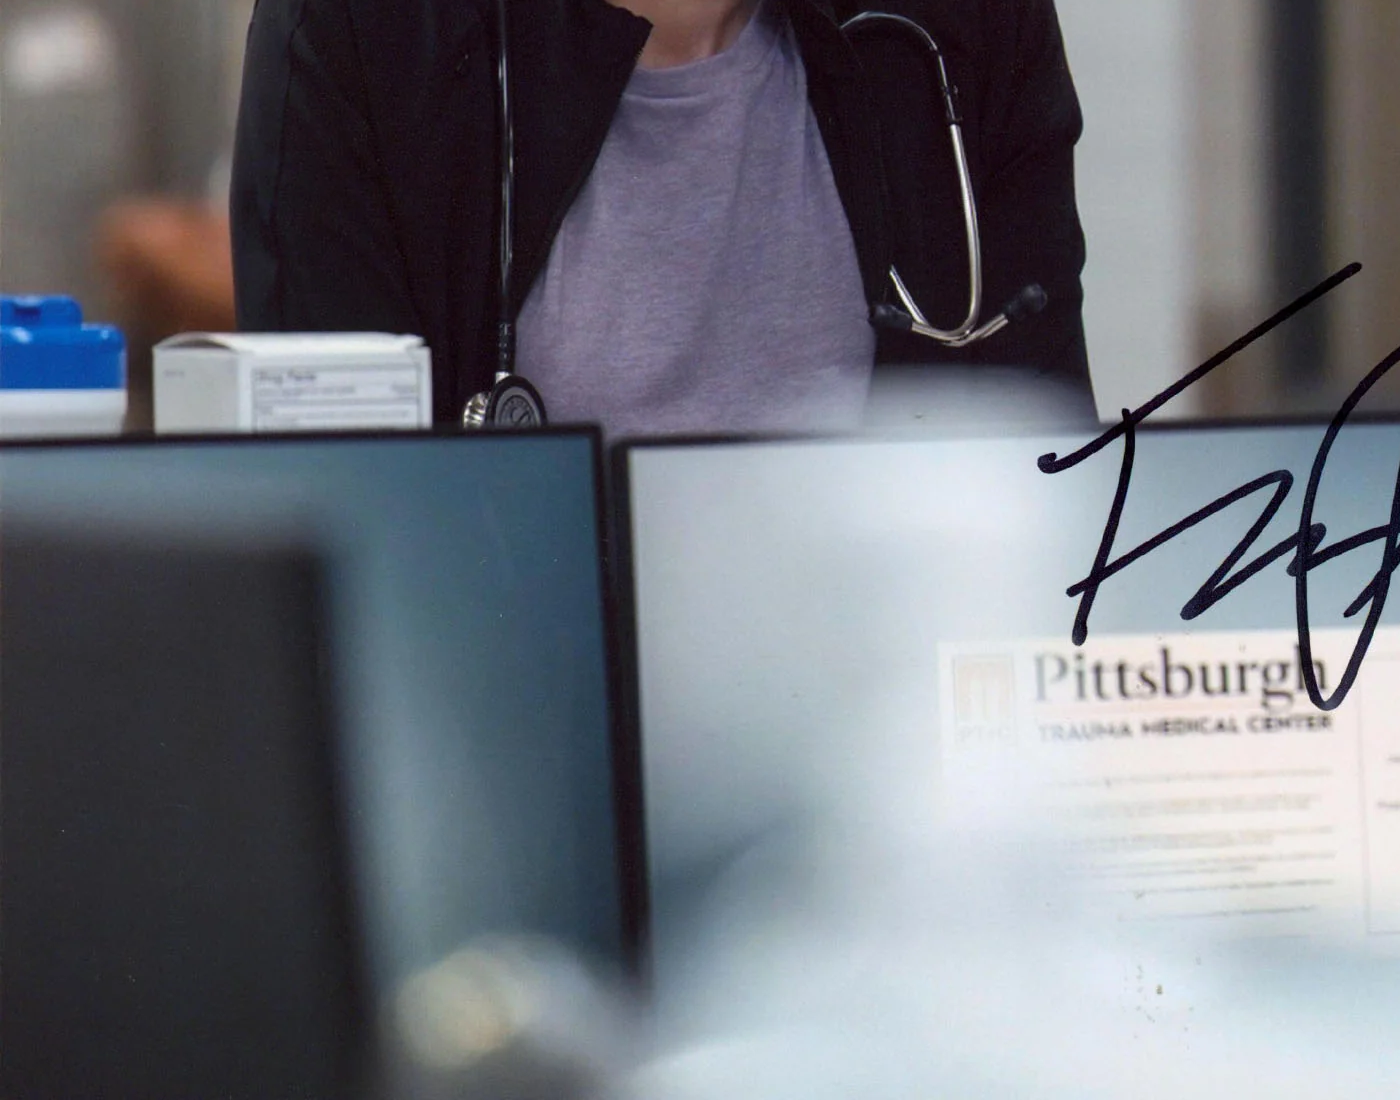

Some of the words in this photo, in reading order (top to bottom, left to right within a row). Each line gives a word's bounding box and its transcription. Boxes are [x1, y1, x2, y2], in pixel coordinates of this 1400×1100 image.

[1034, 643, 1329, 711] Pittsburgh
[1037, 722, 1132, 743] TRAUMA
[1140, 716, 1239, 737] MEDICAL
[1245, 713, 1334, 734] CENTER
